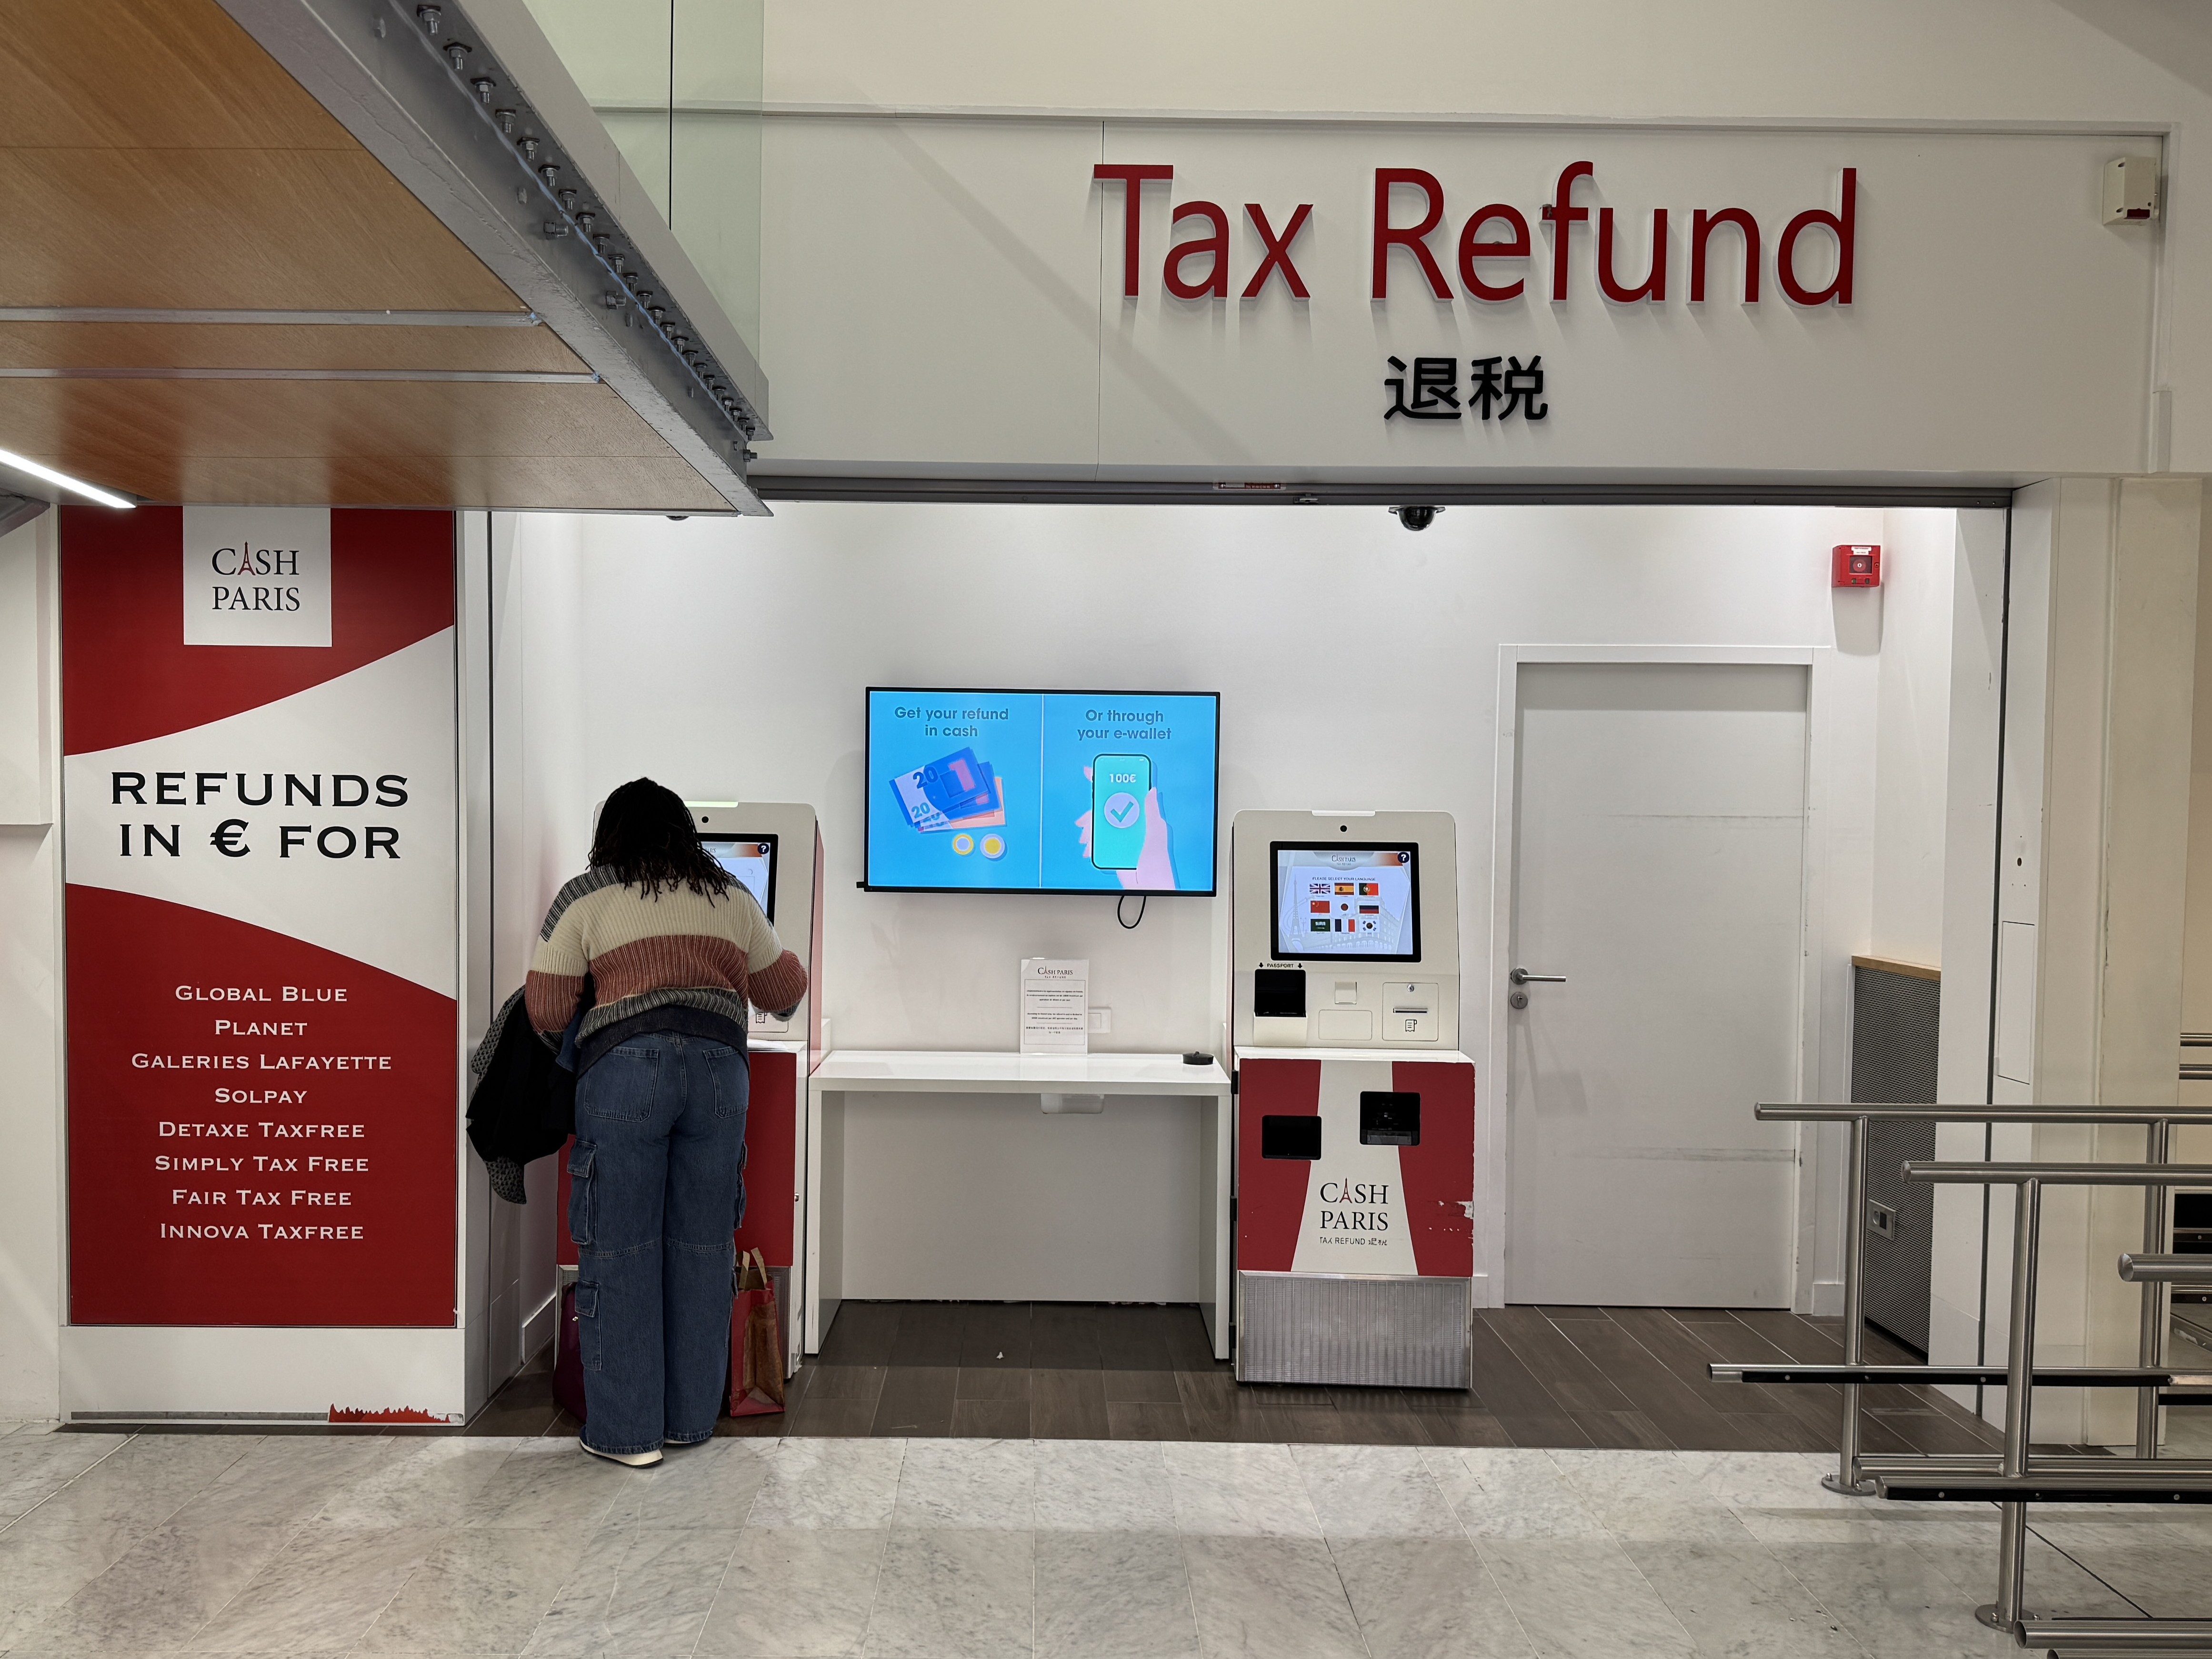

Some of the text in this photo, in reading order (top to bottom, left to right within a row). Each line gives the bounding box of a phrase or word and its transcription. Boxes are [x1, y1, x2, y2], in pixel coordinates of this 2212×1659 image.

[1093, 161, 1857, 308] Tax Refund
[1383, 355, 1549, 421] 退税
[211, 541, 300, 576] CASH
[211, 586, 300, 612] PARIS
[894, 706, 1009, 723] Get your refund
[1085, 709, 1164, 726] Or through
[924, 724, 978, 737] in cash
[1077, 727, 1172, 741] your e-wallet
[912, 766, 939, 789] 20
[1109, 772, 1137, 784] 100€
[111, 771, 409, 808] REFUNDS
[911, 802, 931, 819] 20
[119, 818, 401, 859] IN € FOR
[175, 985, 348, 1002] GLOBAL BLUE
[215, 1019, 308, 1036] PLANET
[131, 1053, 391, 1070] GALERIES LAFAYETTE
[214, 1087, 308, 1104] SOLPAY
[159, 1121, 365, 1138] DETAXE TAXFREE
[155, 1155, 369, 1172] SIMPLY TAX FREE
[172, 1189, 352, 1206] FAIR TAX FREE
[1320, 1177, 1389, 1204] CASH
[1319, 1210, 1389, 1231] PARIS
[160, 1223, 364, 1239] INNOVA TAXFREE
